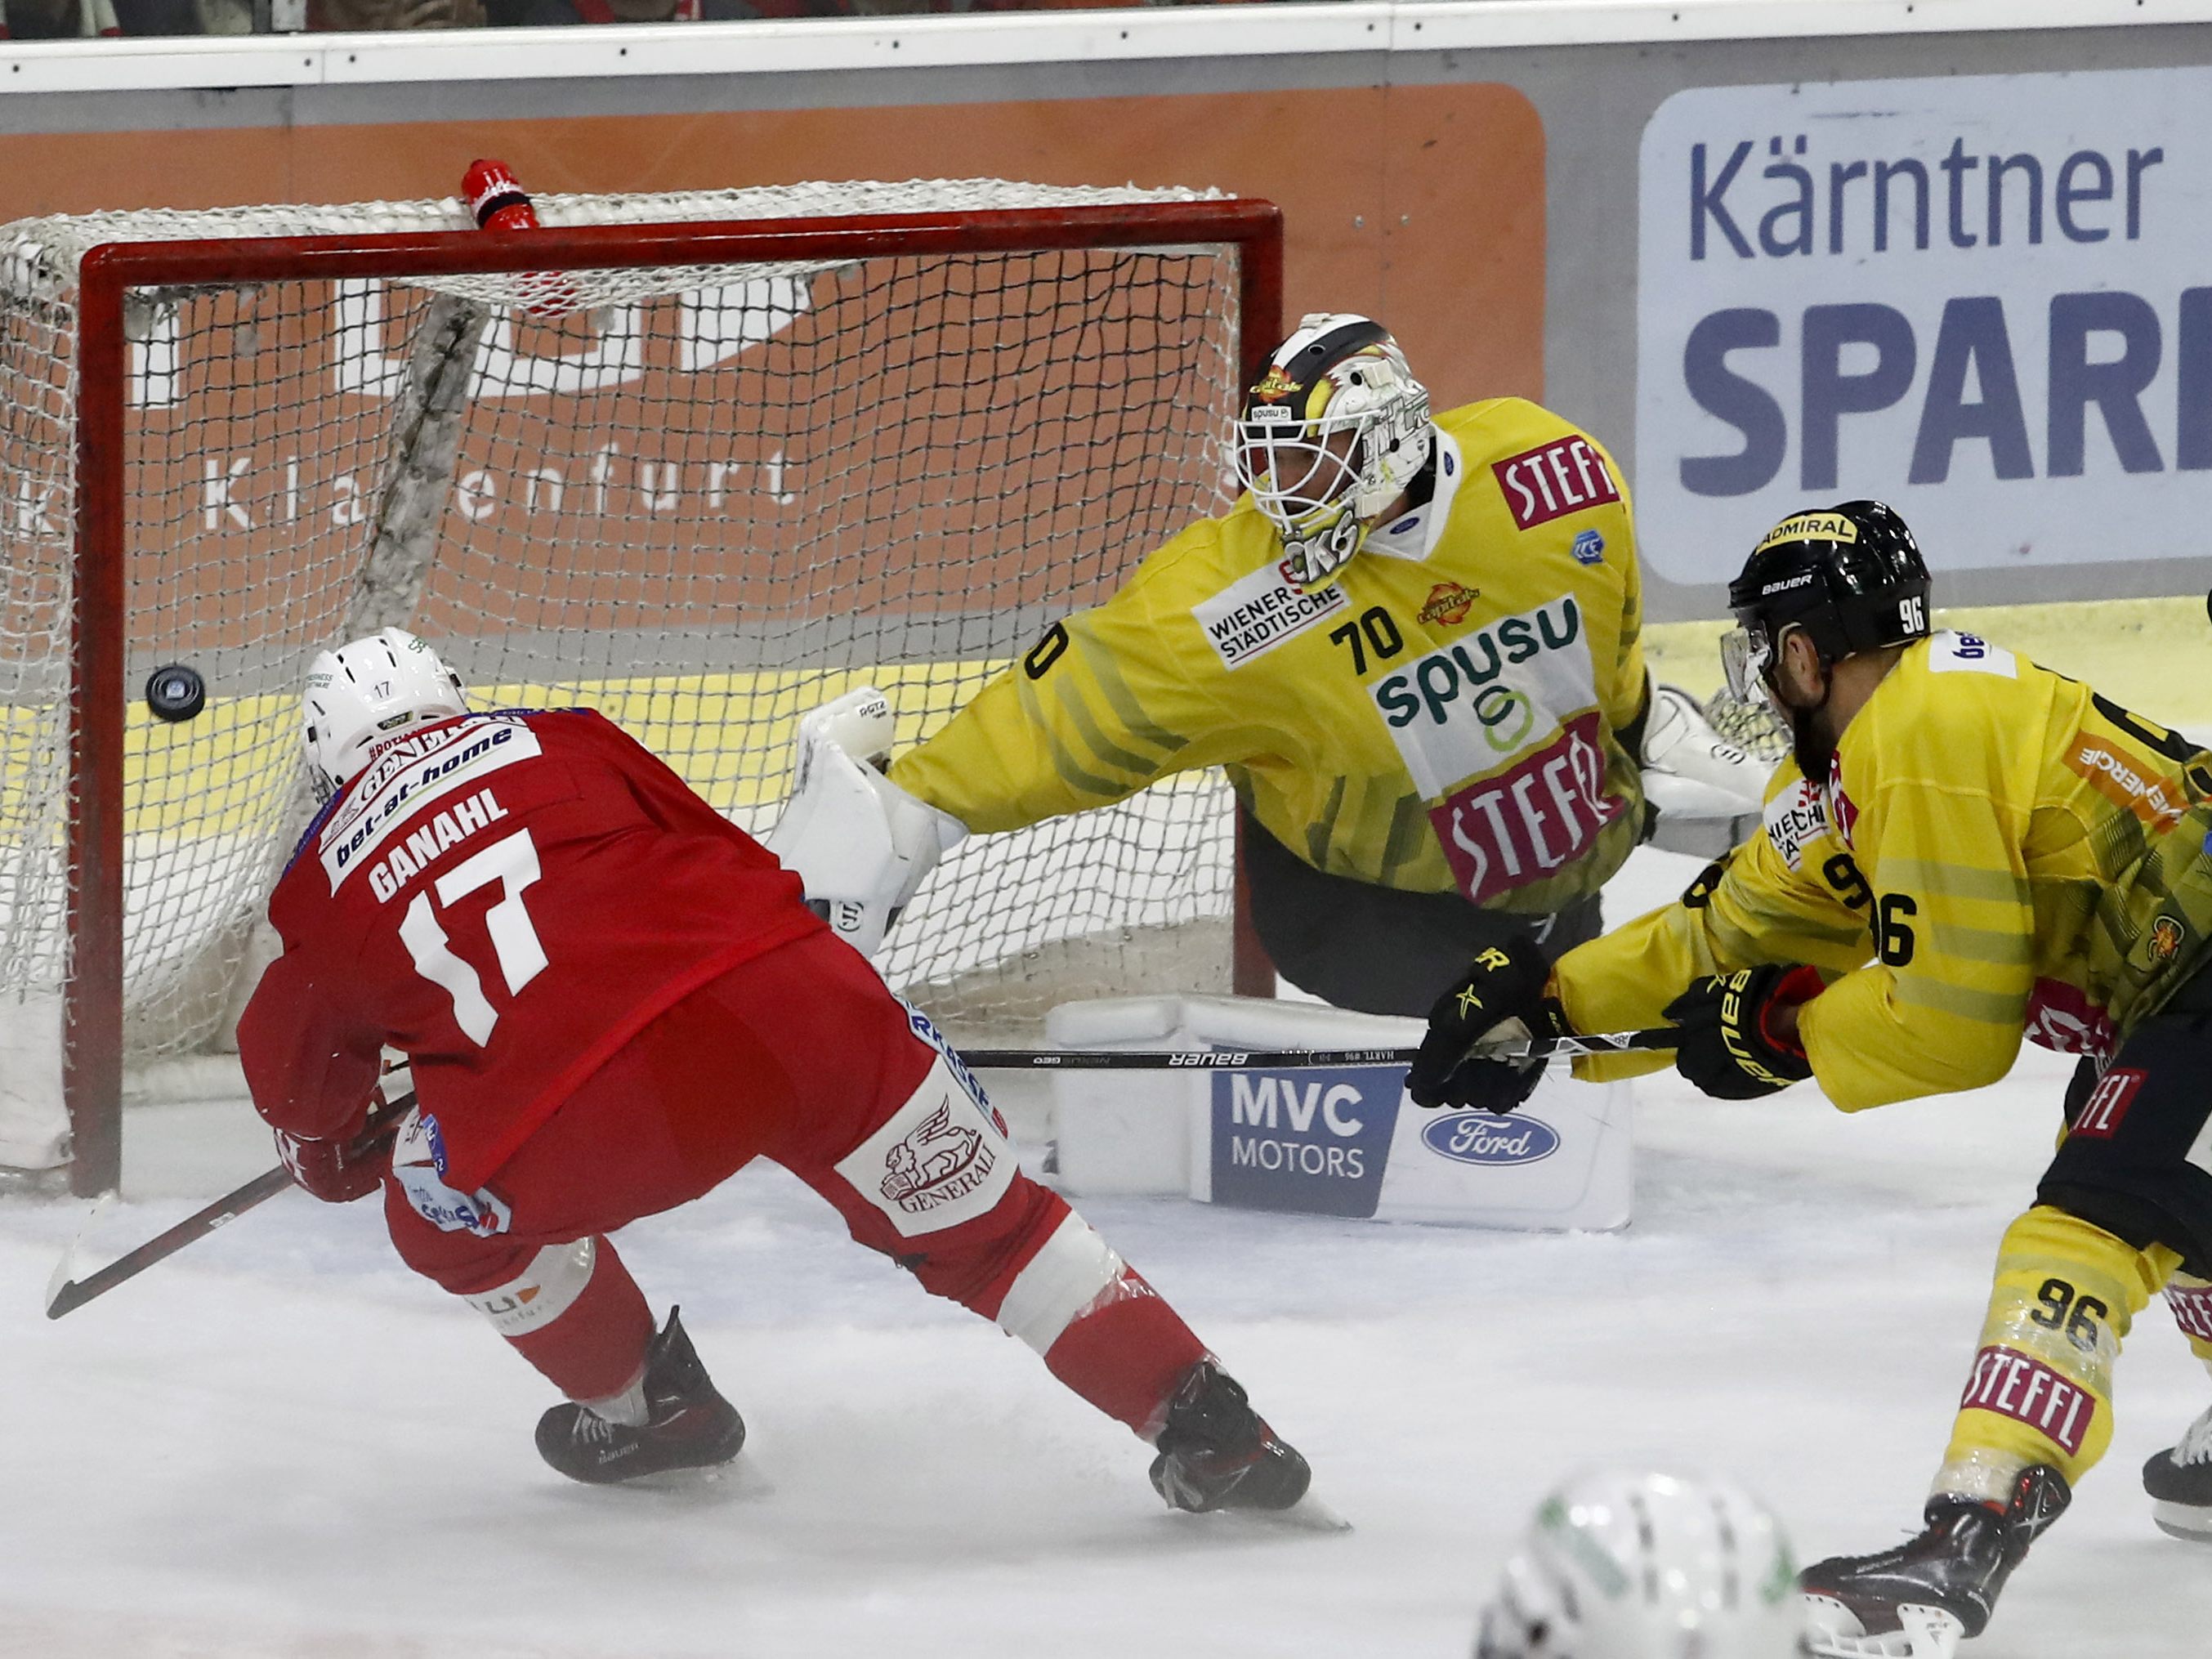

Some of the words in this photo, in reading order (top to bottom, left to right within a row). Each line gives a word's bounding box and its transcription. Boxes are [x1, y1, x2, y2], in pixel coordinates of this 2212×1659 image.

[1690, 134, 2165, 262] Kärntner
[1253, 409, 1279, 418] spusu
[205, 442, 798, 531] Klaenfurt
[1763, 519, 1854, 544] ADMIRAL
[1209, 586, 1292, 641] WIENER
[1220, 587, 1341, 659] STÄDTISCHE
[1329, 606, 1404, 676] 70
[1898, 596, 1925, 634] 96
[373, 681, 391, 699] 17
[1376, 599, 1579, 728] spusu
[336, 727, 513, 869] bet-at-home
[368, 788, 509, 904] GANAHL
[398, 827, 549, 1048] 17
[1231, 1073, 1364, 1138] MVC
[1450, 1118, 1533, 1156] Ford
[899, 1143, 996, 1214] GENERALI
[1231, 1136, 1364, 1179] MOTORS
[2031, 1278, 2108, 1353] 96
[1963, 1353, 2085, 1448] STEFFL
